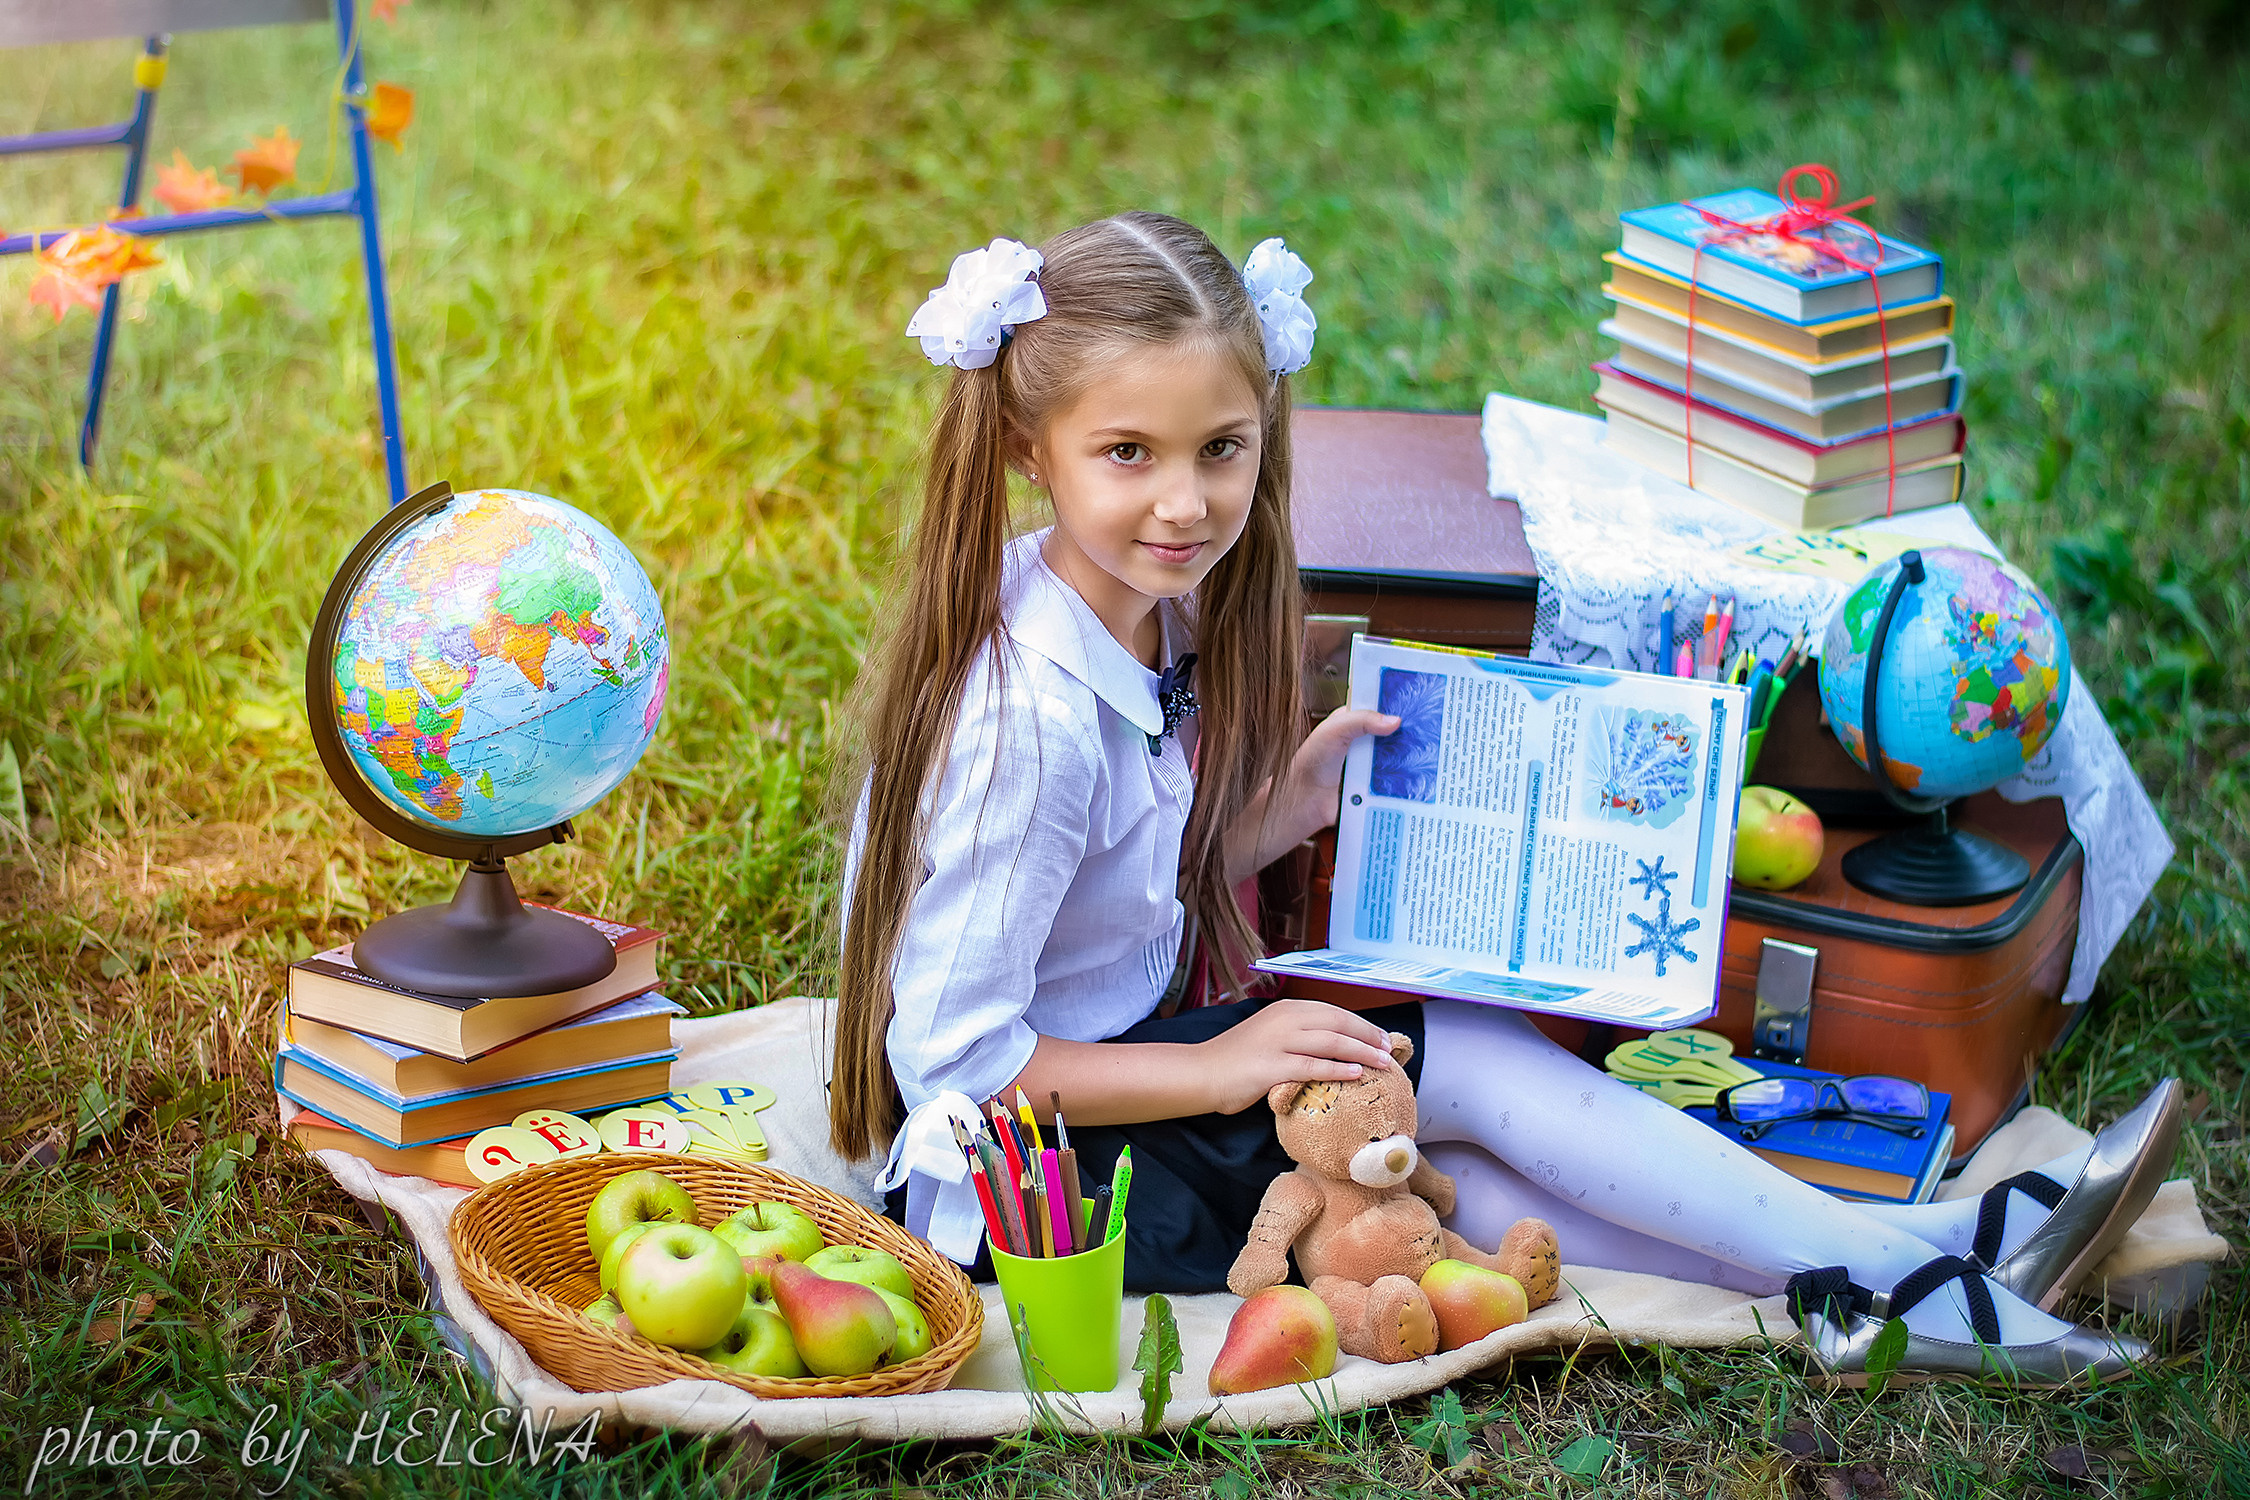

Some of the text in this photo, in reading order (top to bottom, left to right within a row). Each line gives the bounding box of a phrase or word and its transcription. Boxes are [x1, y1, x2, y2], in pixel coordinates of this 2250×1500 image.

[1503, 667, 1581, 684] ЭТА ДИВНАЯ ПРИРОДА
[1707, 709, 1723, 801] ПОЧЕМУ СНЕГ БЕЛЫЙ?
[1530, 770, 1540, 806] ПОЧЕМУ
[1526, 805, 1537, 843] БЫВАЮТ
[1522, 841, 1533, 885] СНЕЖНЫЕ
[1519, 884, 1529, 915] УЗОРЫ
[1514, 926, 1524, 962] ОКНАХ?
[713, 1086, 755, 1106] Р
[529, 1116, 590, 1154] Ё
[622, 1118, 667, 1150] Е
